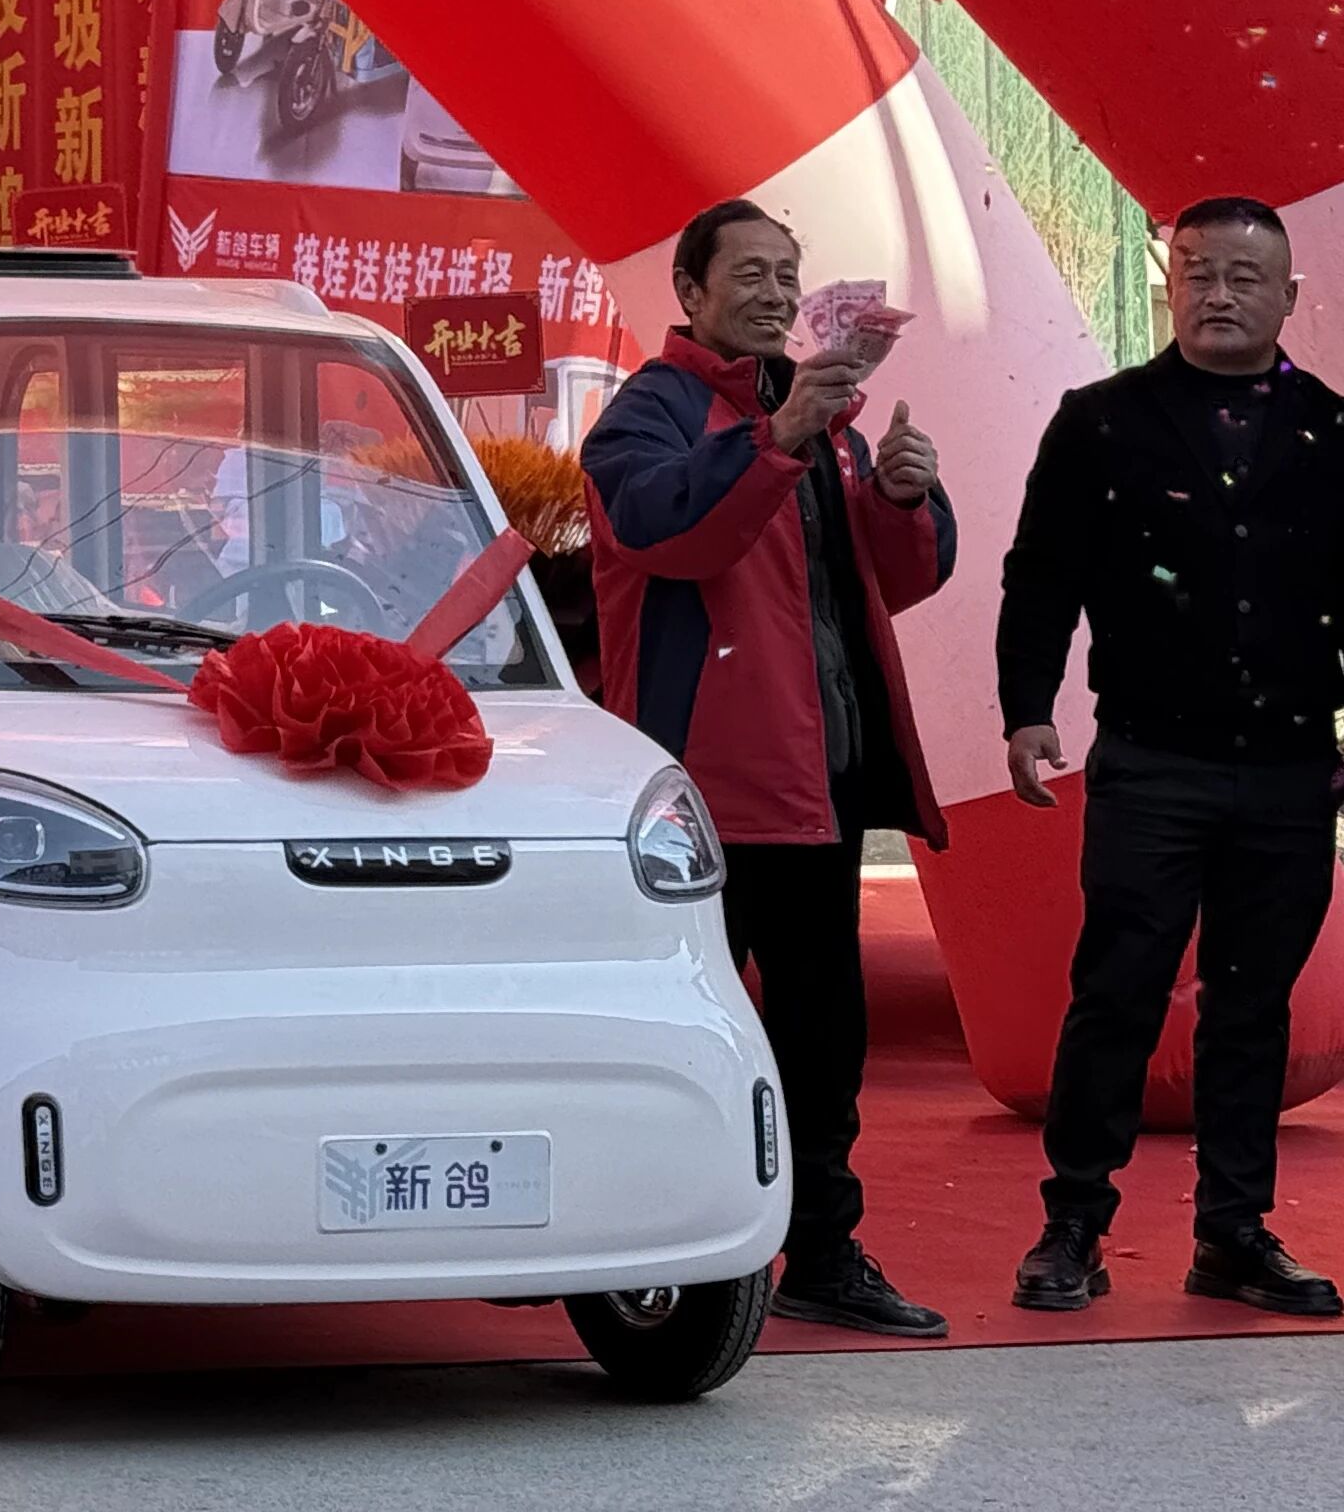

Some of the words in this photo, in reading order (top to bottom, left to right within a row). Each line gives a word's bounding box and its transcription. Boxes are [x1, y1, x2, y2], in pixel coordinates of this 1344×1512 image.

[423, 313, 527, 377] 开业大吉
[307, 845, 497, 869] XINGE
[38, 1114, 55, 1190] XINGE
[385, 1160, 491, 1210] 新鸽
